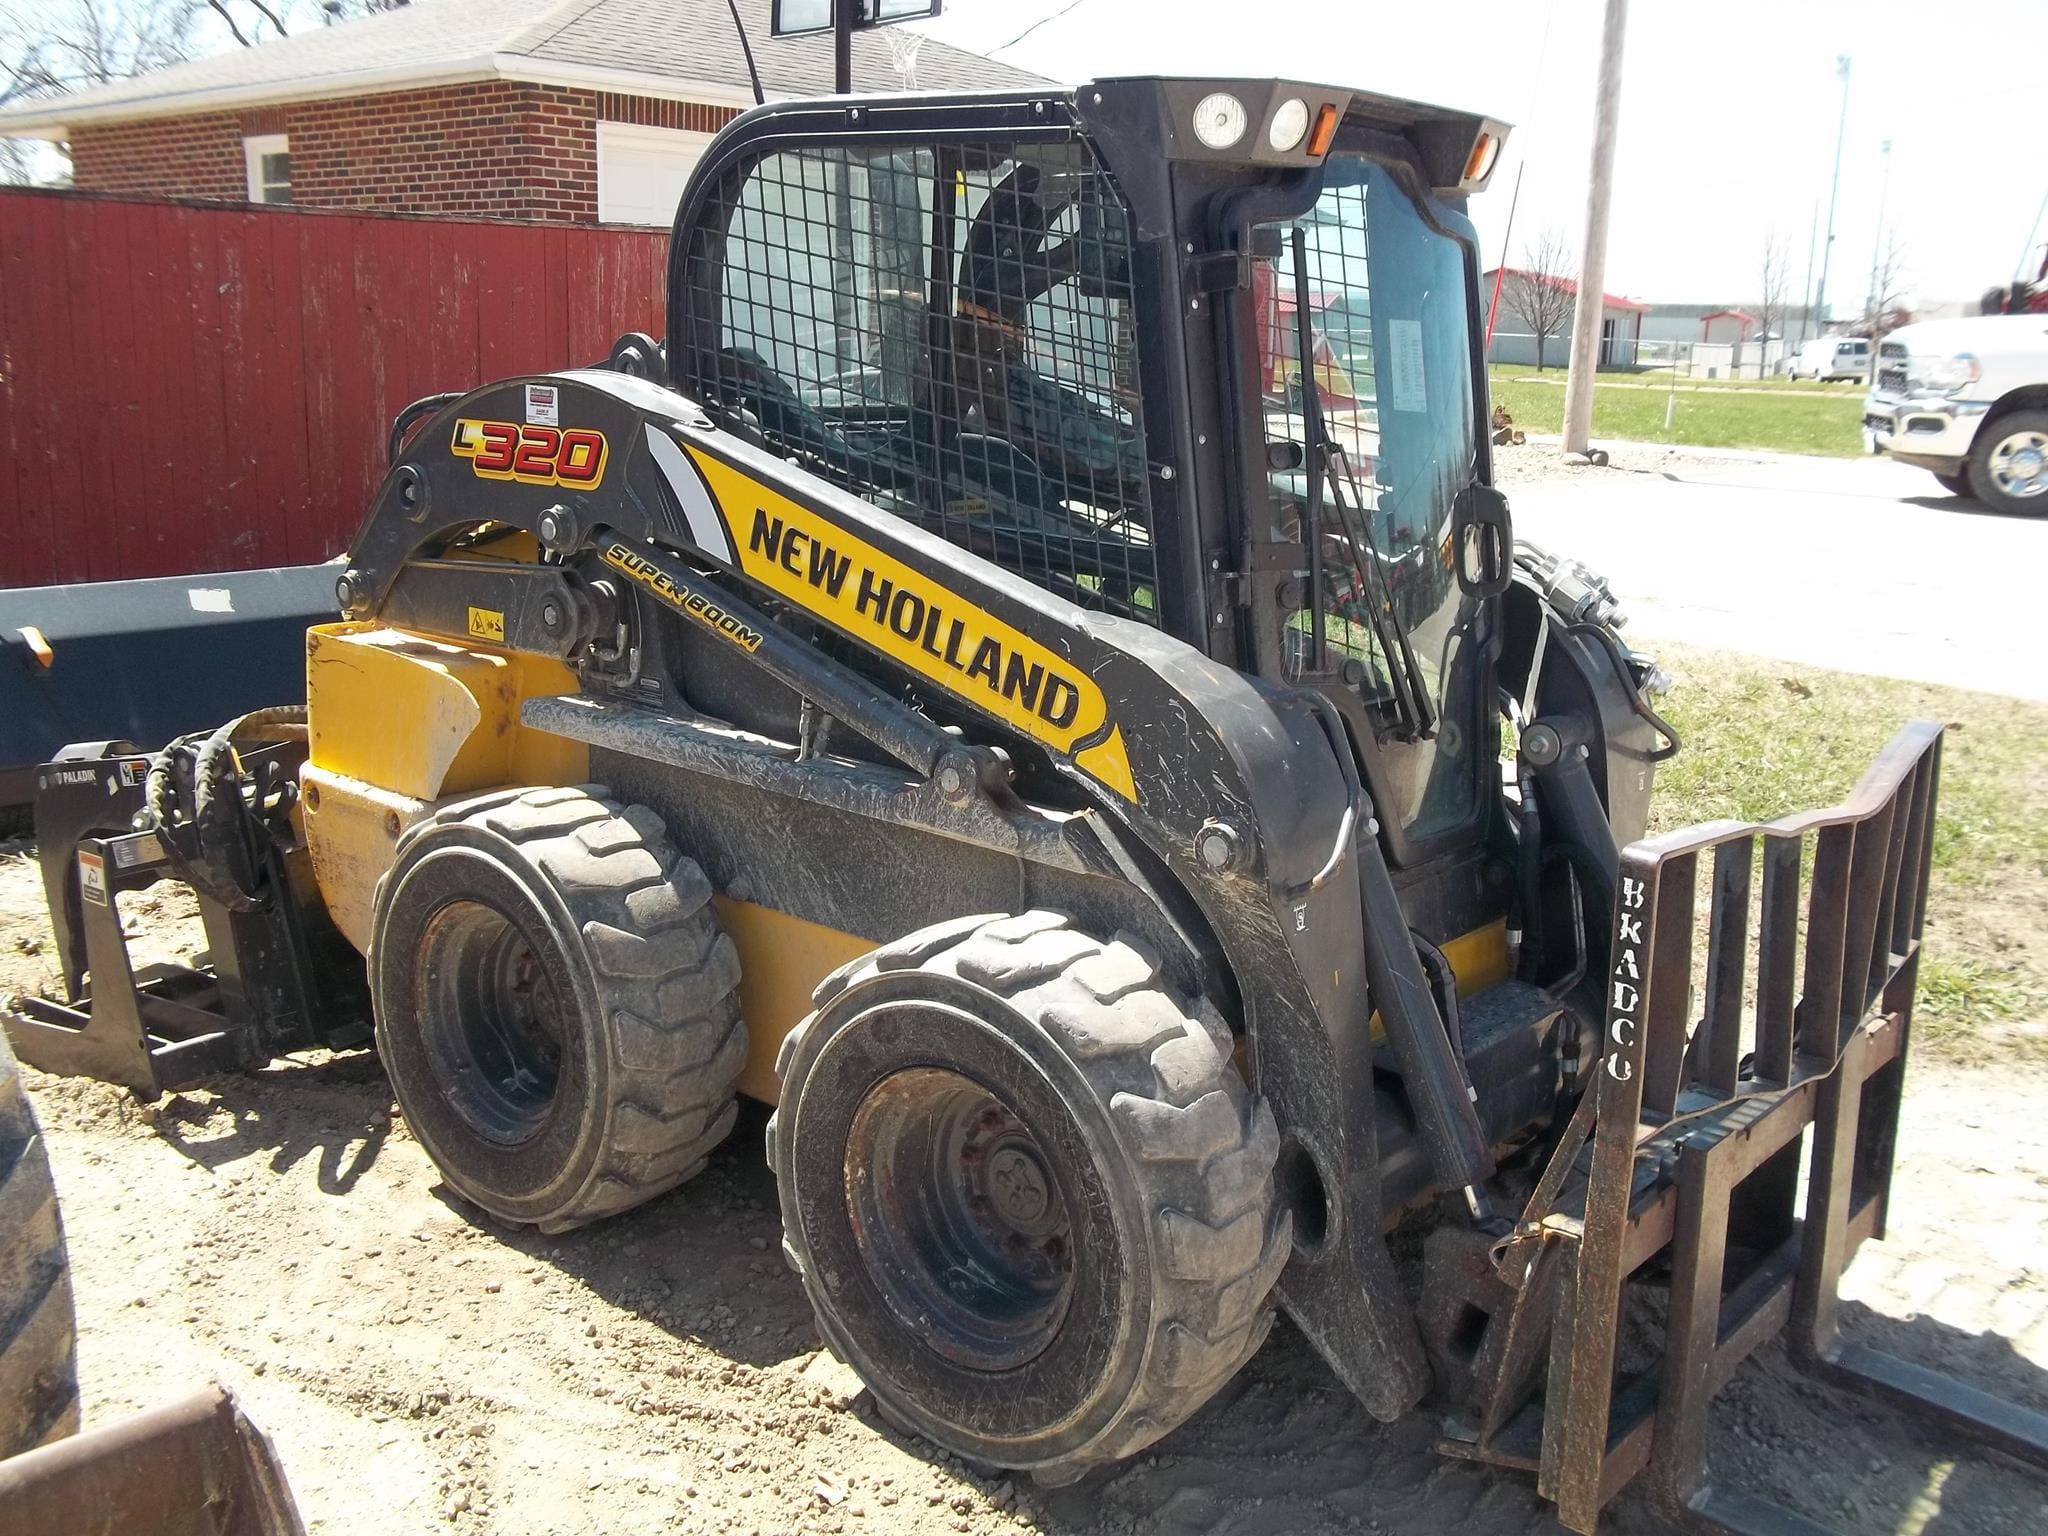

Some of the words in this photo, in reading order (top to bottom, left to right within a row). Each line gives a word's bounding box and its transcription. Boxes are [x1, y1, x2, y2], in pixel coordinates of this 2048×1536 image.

[452, 420, 606, 486] L320
[685, 594, 764, 653] BOOM
[749, 507, 852, 599] NEW
[855, 567, 1080, 731] HOLLAND
[63, 769, 97, 783] PALADIN
